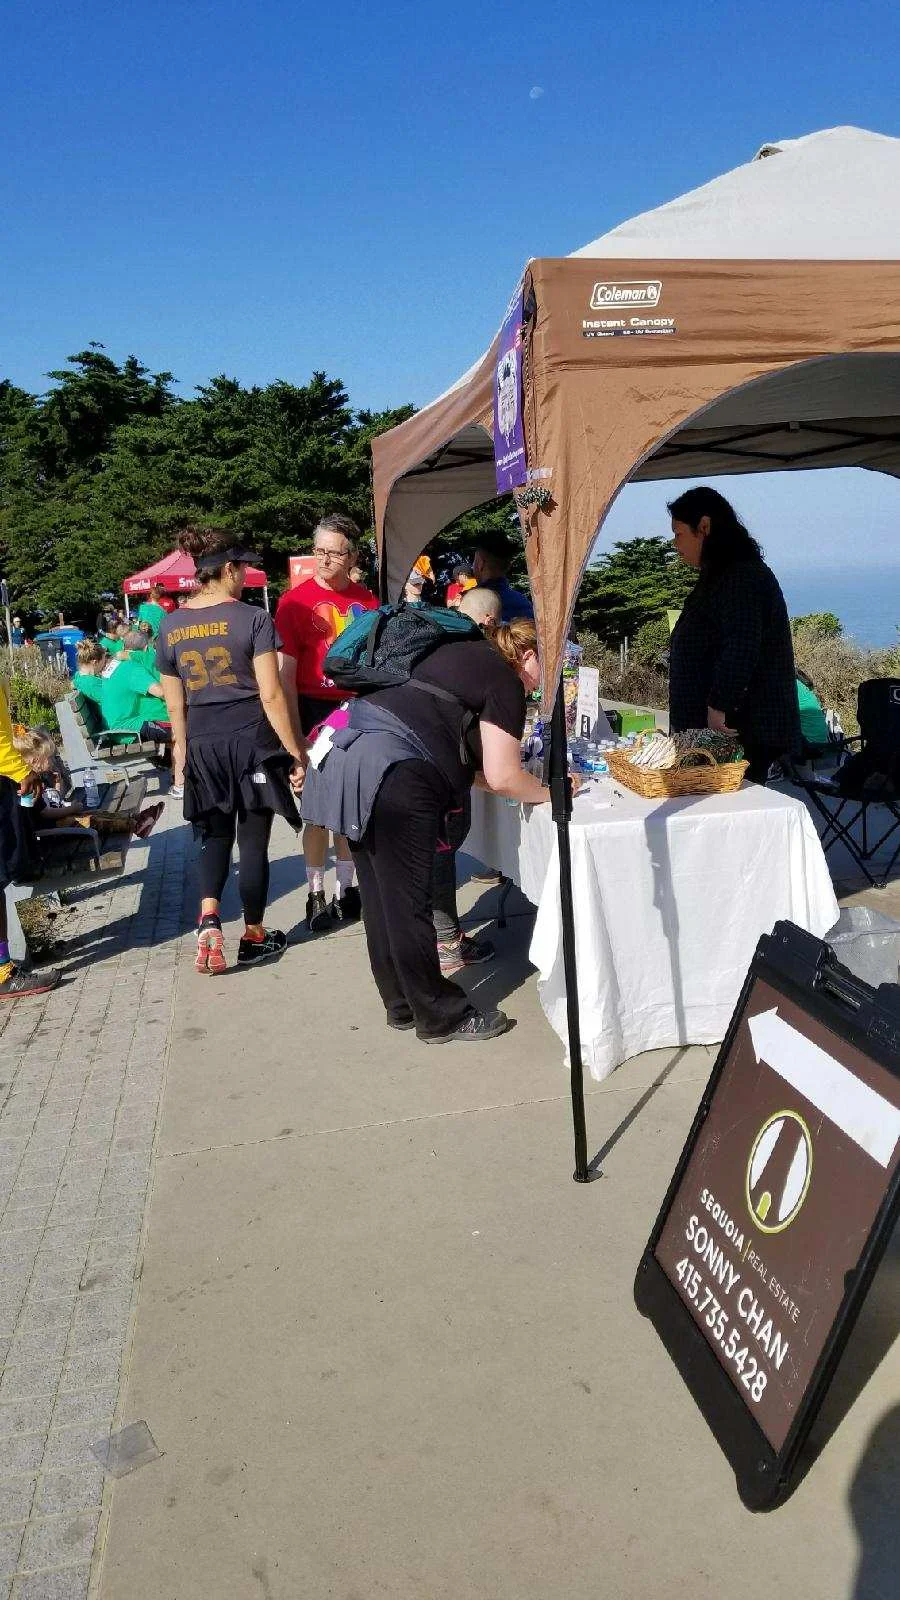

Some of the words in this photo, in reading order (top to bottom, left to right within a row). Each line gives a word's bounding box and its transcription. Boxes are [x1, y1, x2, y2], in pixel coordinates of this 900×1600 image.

[597, 285, 647, 302] Coleman
[582, 319, 626, 329] Instant
[630, 317, 675, 329] Canopy
[167, 621, 229, 647] ADVANCE
[180, 646, 238, 691] 32
[701, 1188, 745, 1252] SEQUOIA
[747, 1249, 768, 1284] REAL
[768, 1276, 801, 1324] ESTATE
[685, 1215, 741, 1295] SONNY
[737, 1287, 789, 1371] CHAN
[675, 1257, 768, 1403] 415.735.5428
